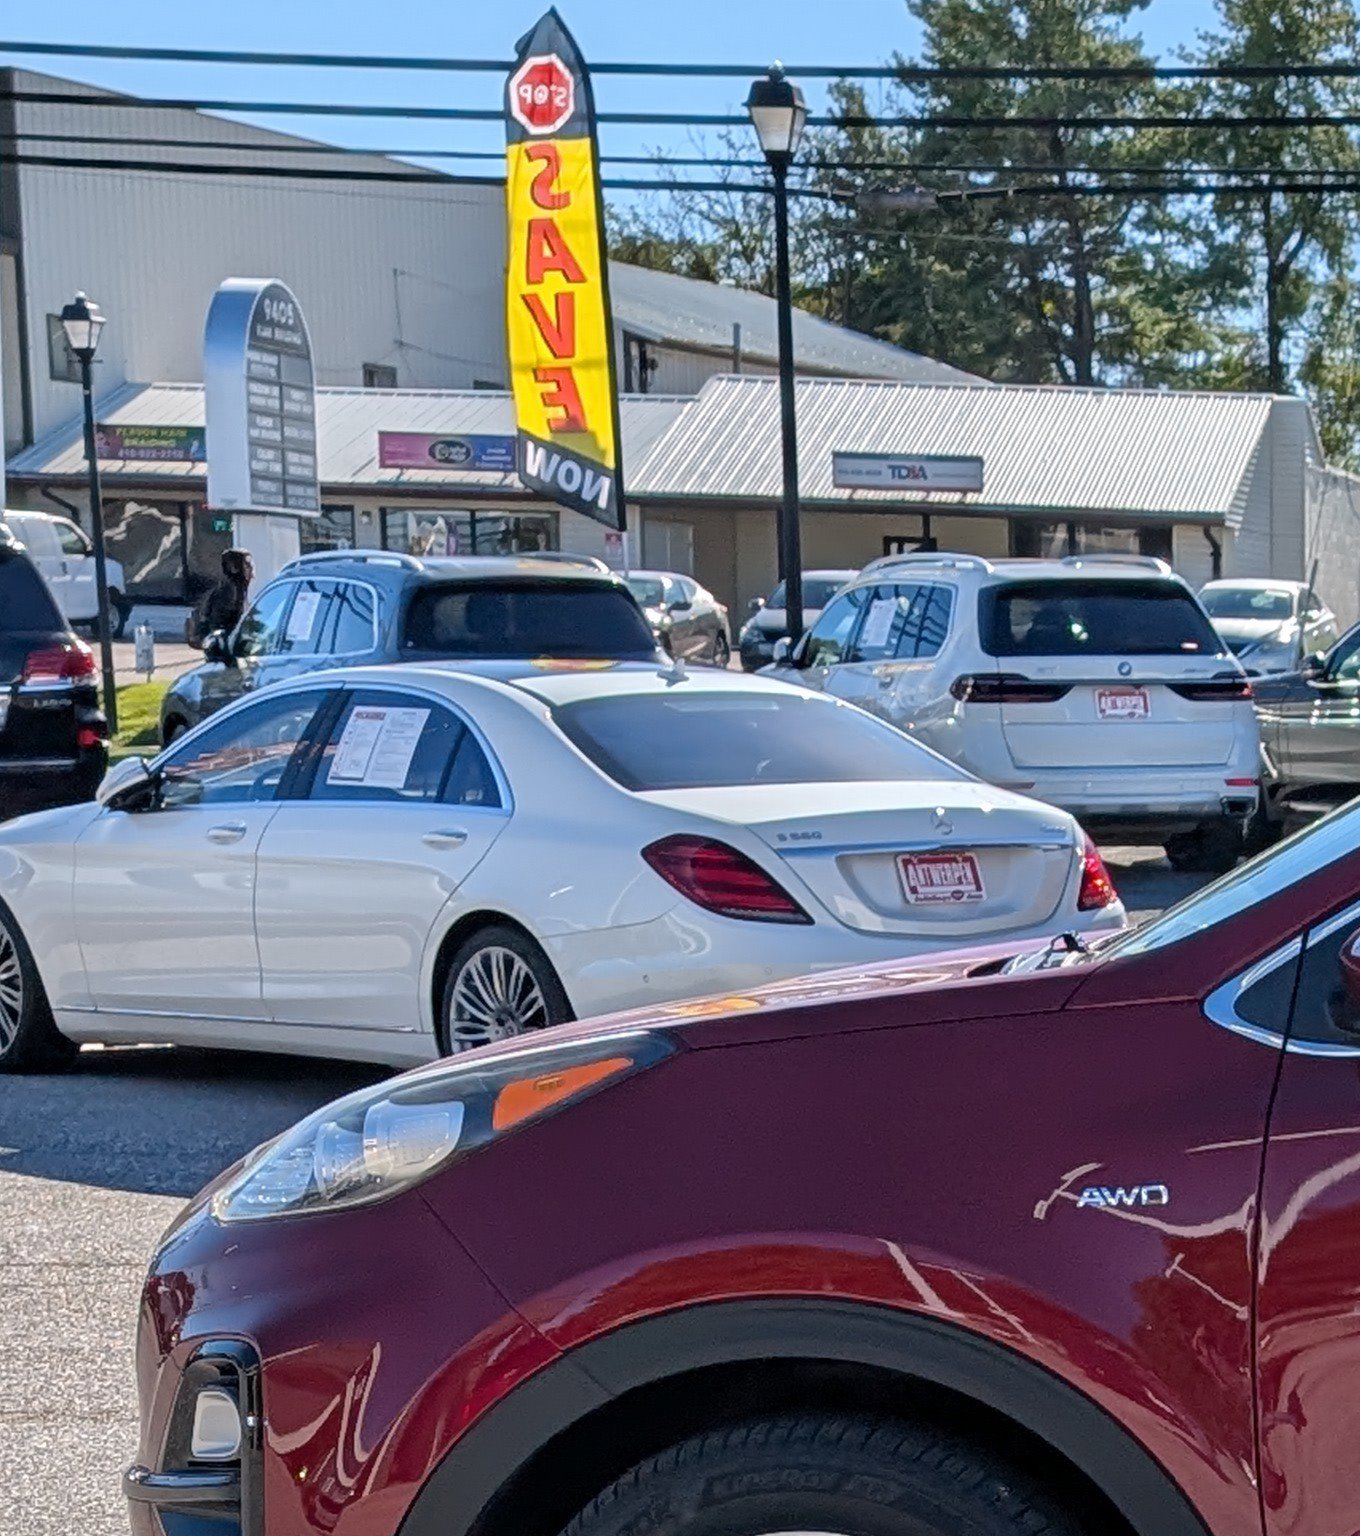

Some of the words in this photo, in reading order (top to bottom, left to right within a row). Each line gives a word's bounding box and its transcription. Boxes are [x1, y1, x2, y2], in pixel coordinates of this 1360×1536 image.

[263, 298, 294, 326] 9405
[907, 863, 976, 891] ANTWERPEN
[1076, 1184, 1169, 1207] AWD
